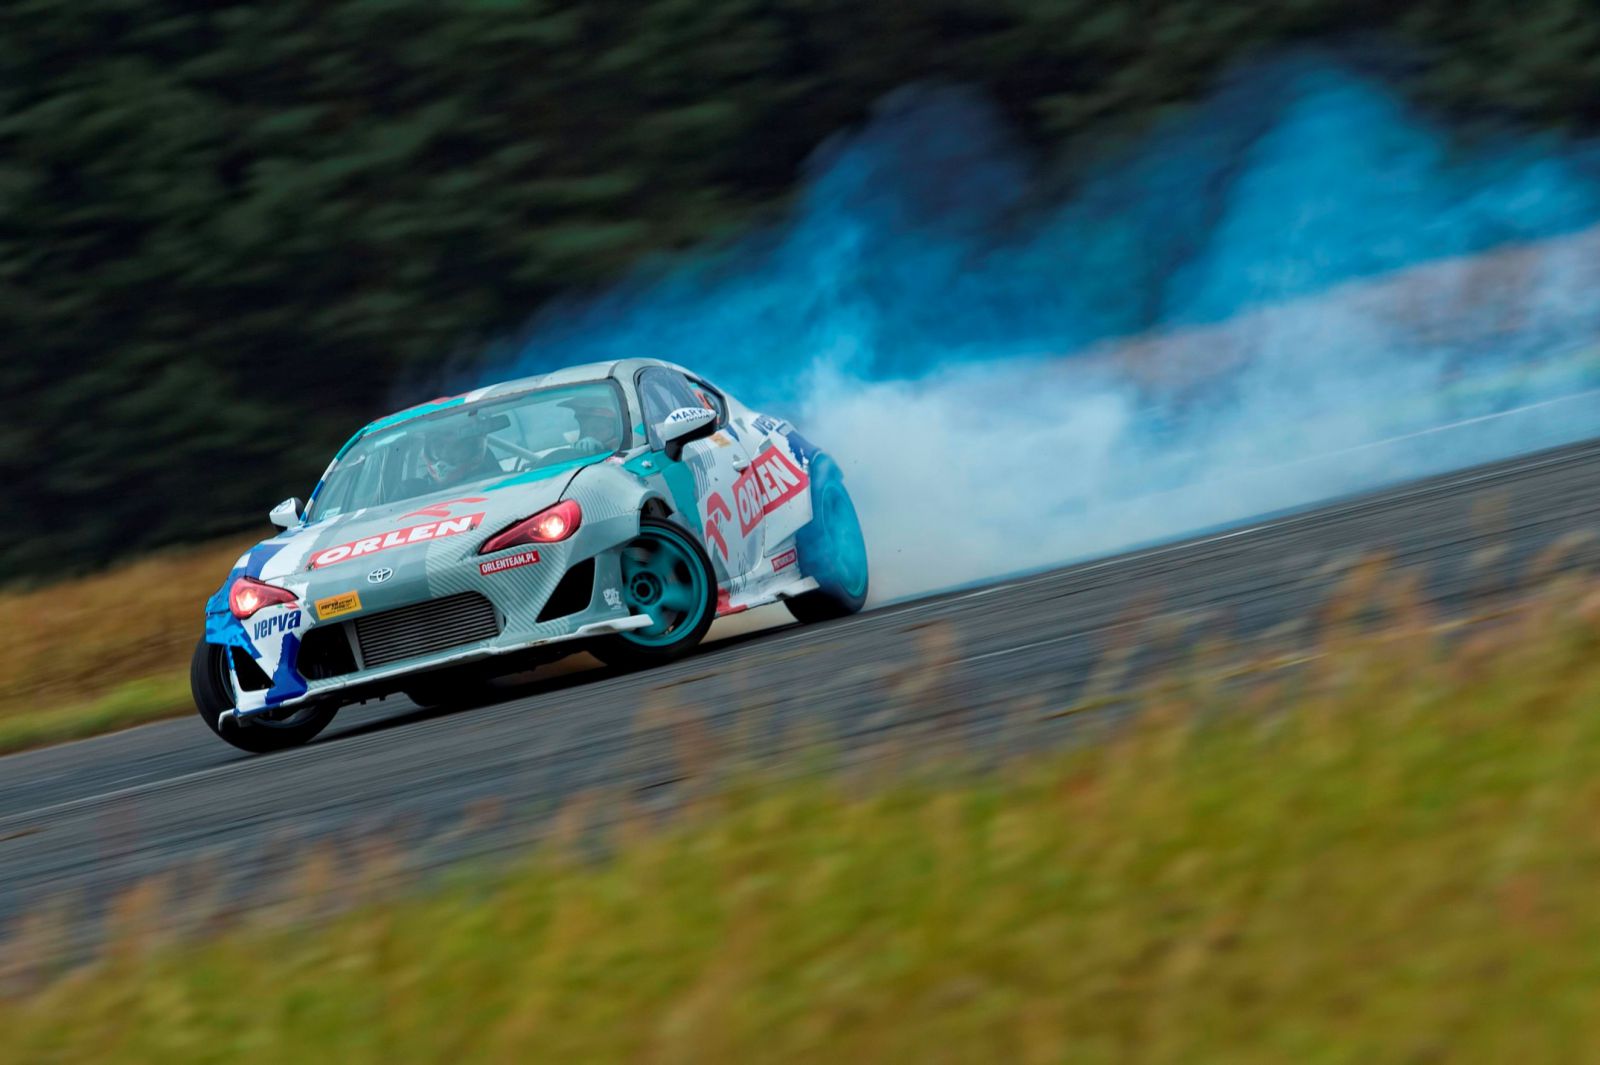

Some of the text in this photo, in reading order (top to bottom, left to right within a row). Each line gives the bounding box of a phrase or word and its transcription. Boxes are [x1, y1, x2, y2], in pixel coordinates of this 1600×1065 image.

[738, 454, 801, 526] ORLEN
[316, 516, 473, 565] ORLEN
[481, 552, 537, 573] ORLENTEAM.PL
[253, 609, 302, 640] verva
